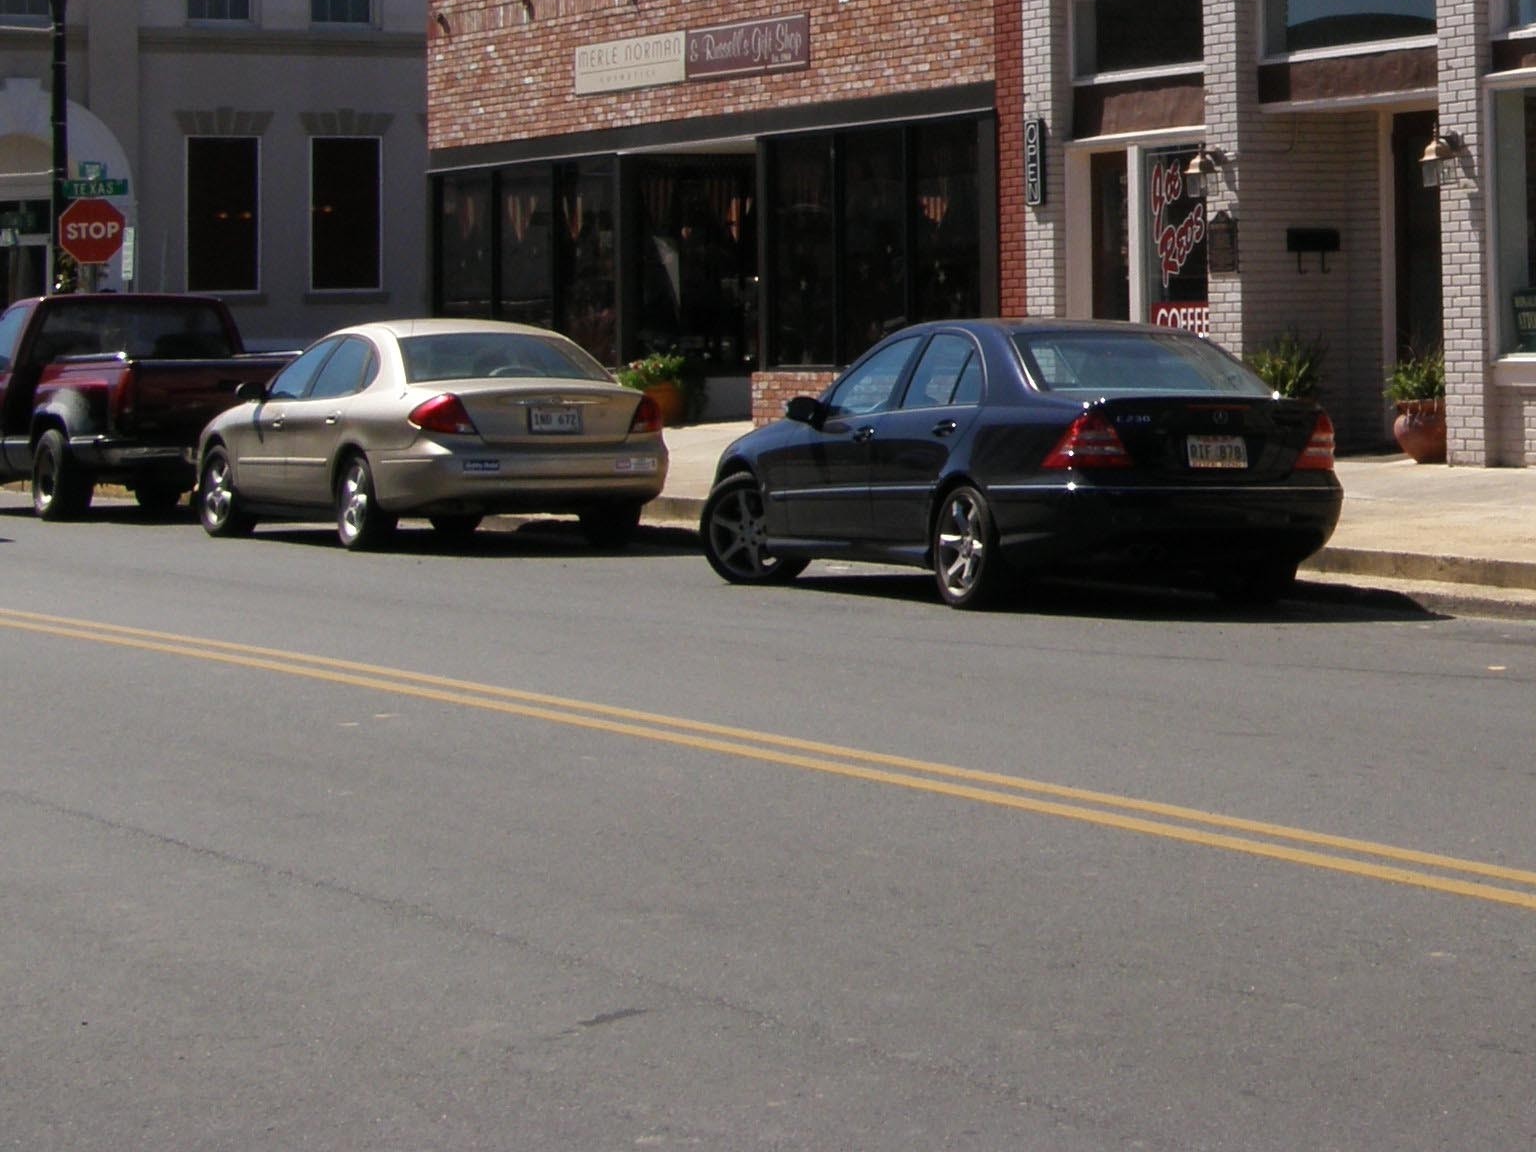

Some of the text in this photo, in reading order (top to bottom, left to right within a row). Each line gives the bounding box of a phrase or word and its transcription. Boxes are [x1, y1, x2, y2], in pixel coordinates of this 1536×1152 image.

[578, 36, 682, 69] MERLE NORMAN
[751, 26, 774, 62] Gift
[775, 23, 802, 57] Shop
[1026, 123, 1040, 202] OPEN
[72, 181, 115, 196] TEXAS
[66, 222, 120, 240] STOP
[1156, 307, 1210, 338] COFFEE
